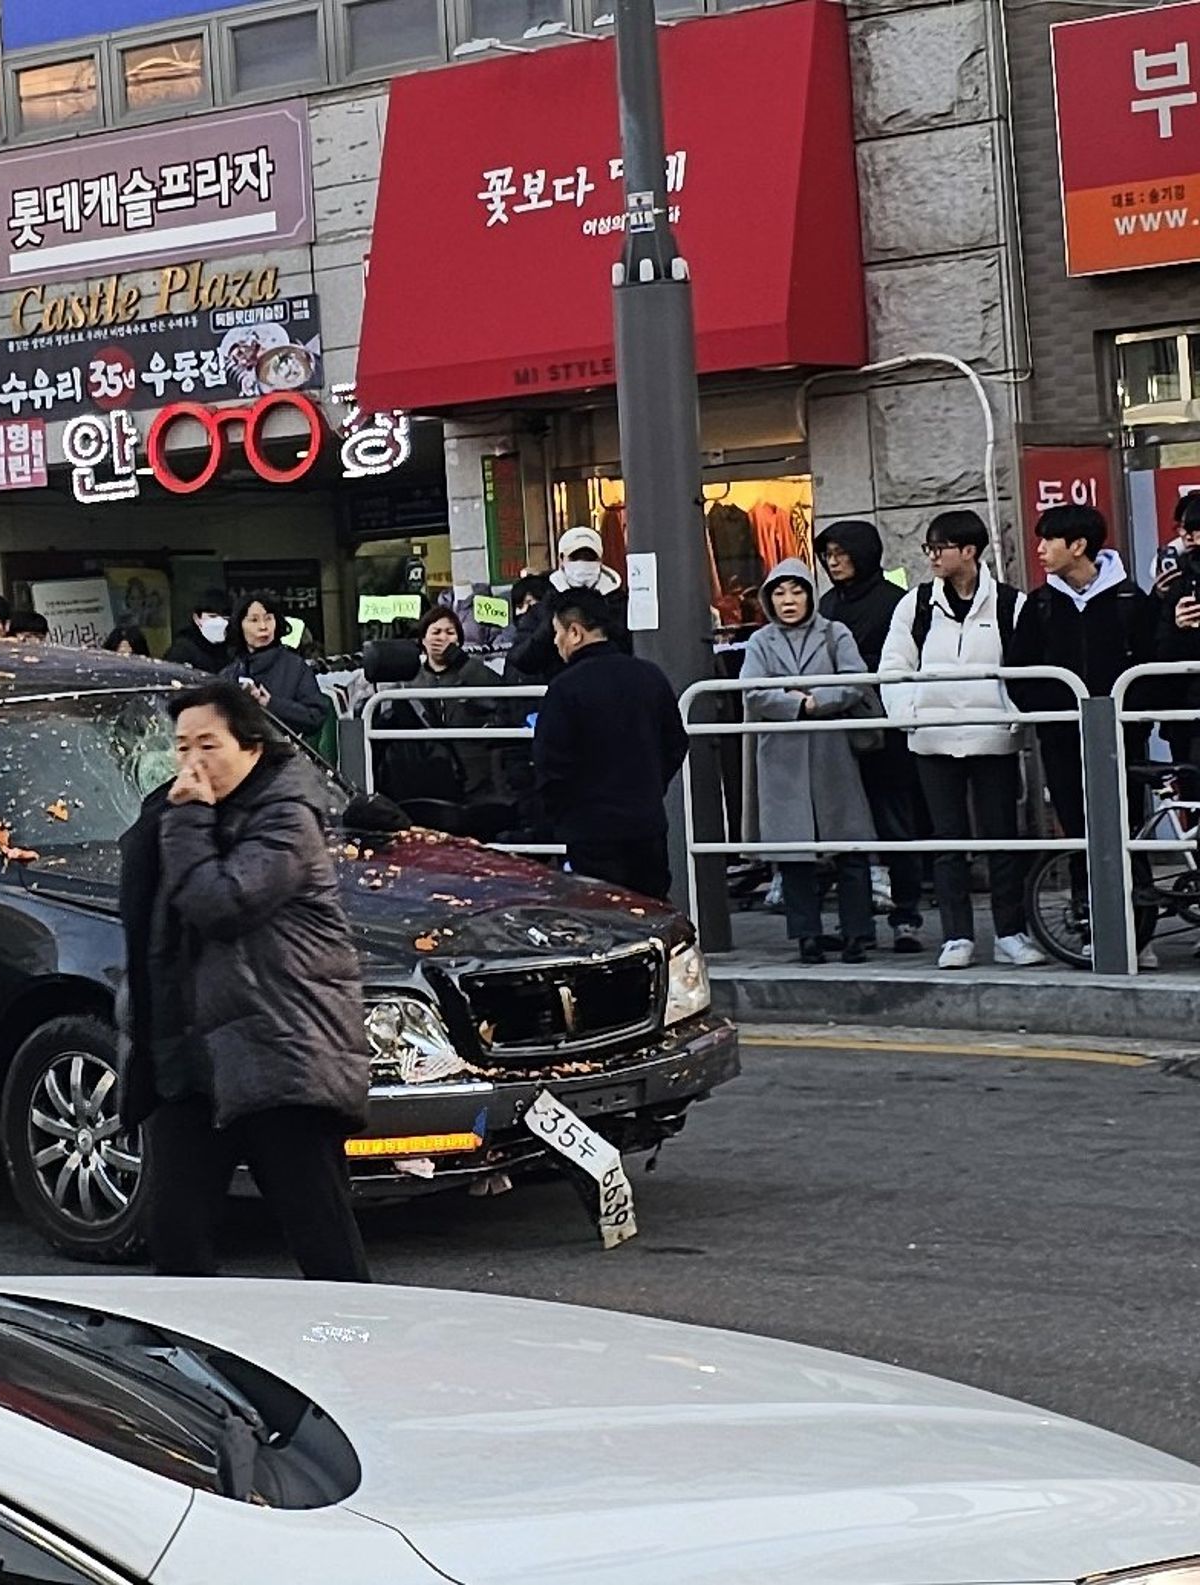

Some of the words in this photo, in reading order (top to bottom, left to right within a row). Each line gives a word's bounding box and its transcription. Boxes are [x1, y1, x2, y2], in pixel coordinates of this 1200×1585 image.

[1131, 41, 1198, 138] 부
[8, 146, 275, 248] 롯데캐슬프라자
[478, 166, 595, 227] 꽃보다
[1114, 207, 1199, 236] www.
[10, 275, 141, 335] Castle
[153, 260, 280, 316] Plaza
[141, 347, 228, 397] 우동집
[62, 409, 141, 502] 안
